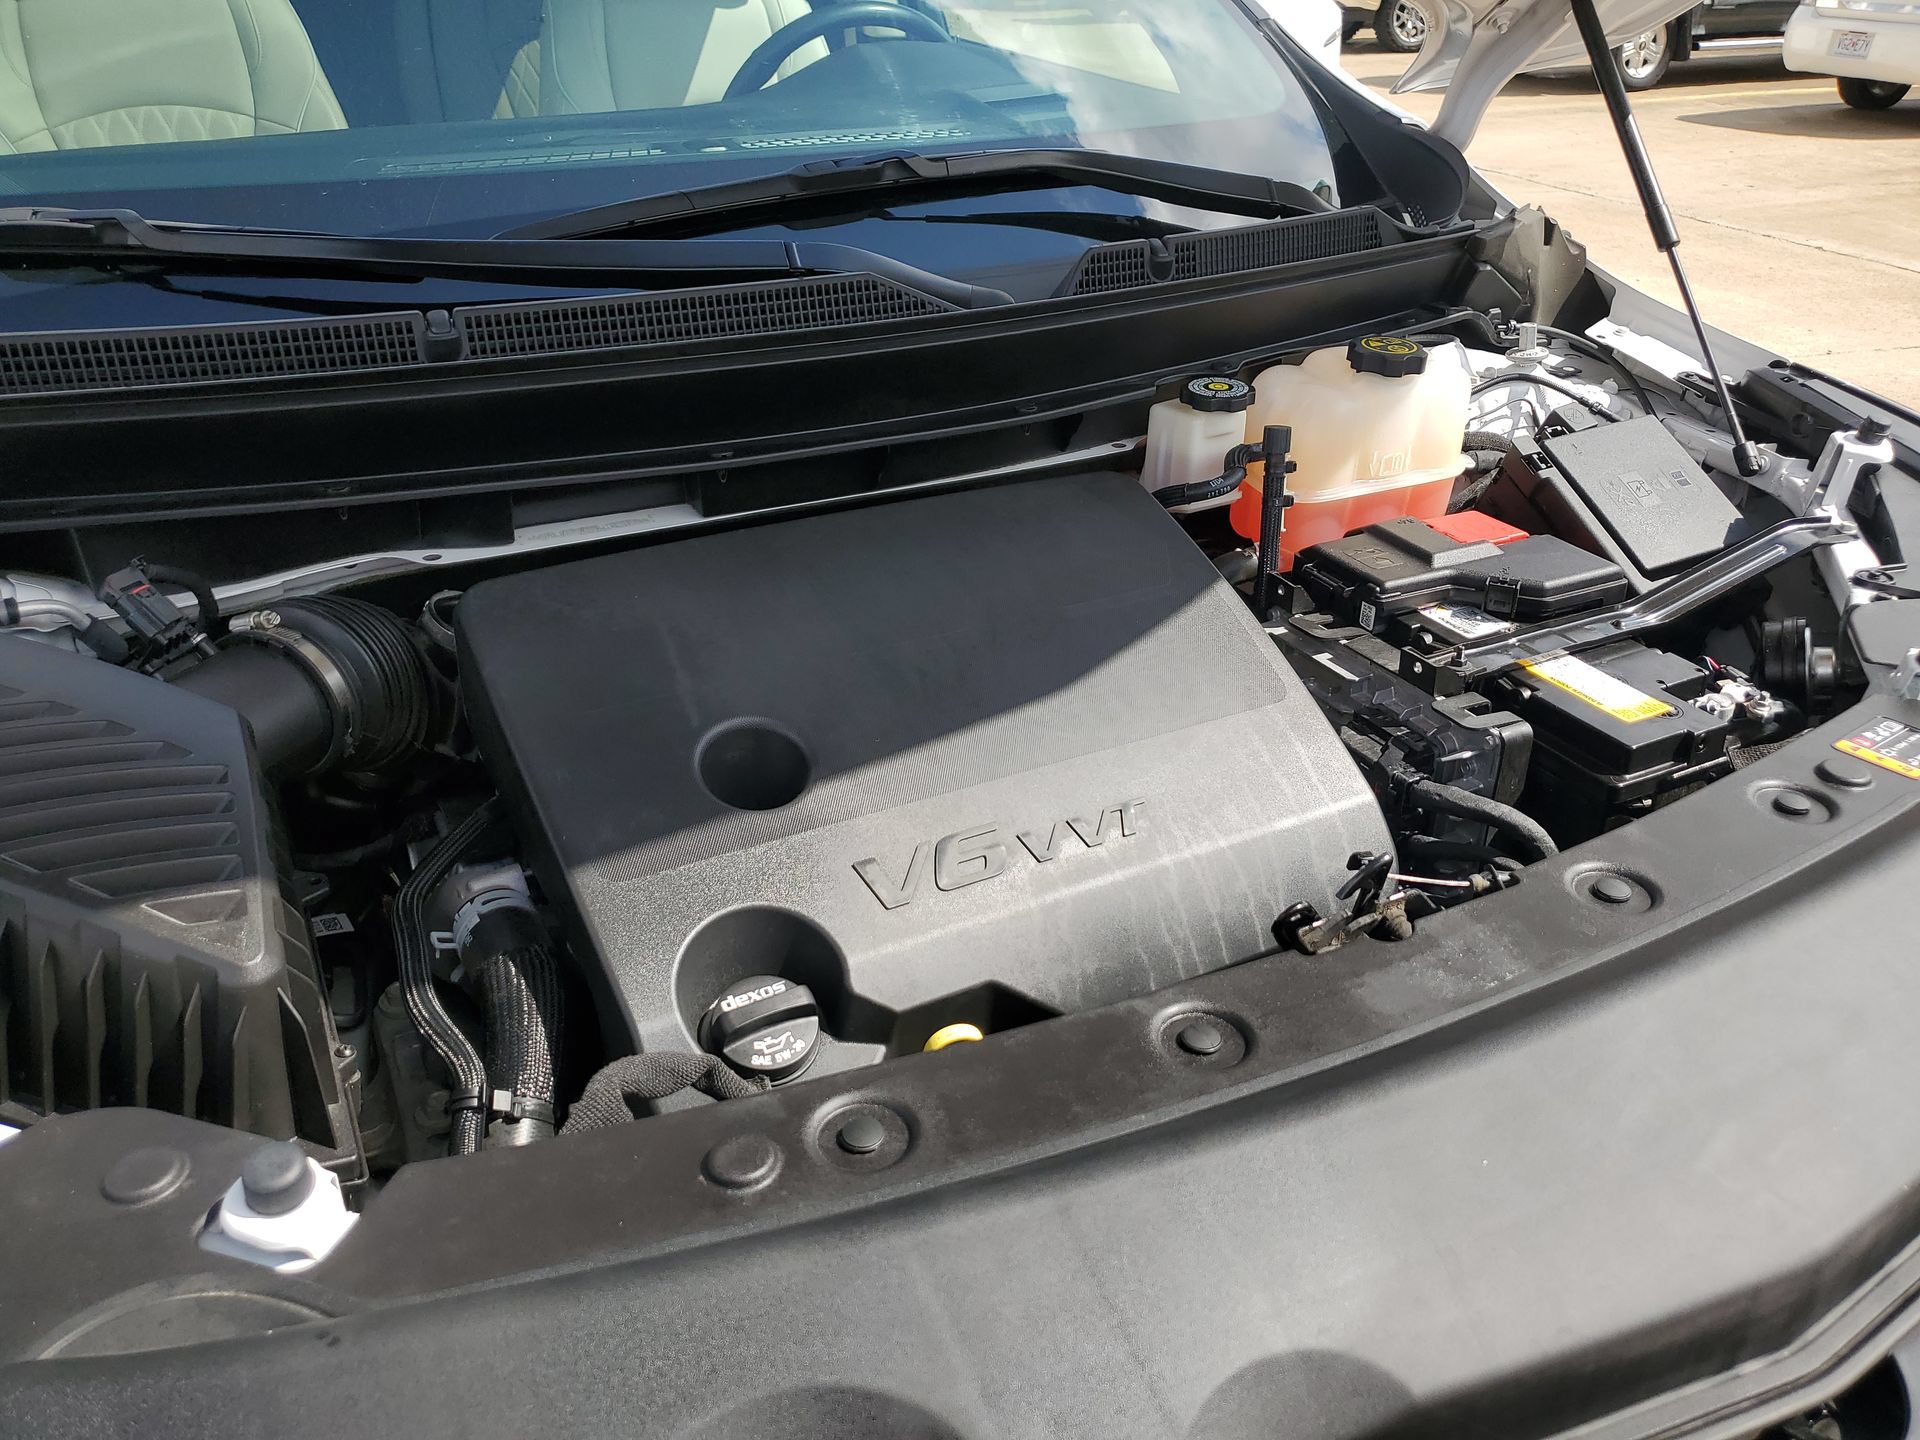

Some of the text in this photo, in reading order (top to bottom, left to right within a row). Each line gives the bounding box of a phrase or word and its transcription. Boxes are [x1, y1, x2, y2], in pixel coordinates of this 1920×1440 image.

[851, 797, 1146, 910] V6 VVT
[720, 980, 786, 1012] dexos
[750, 1054, 773, 1066] SAE
